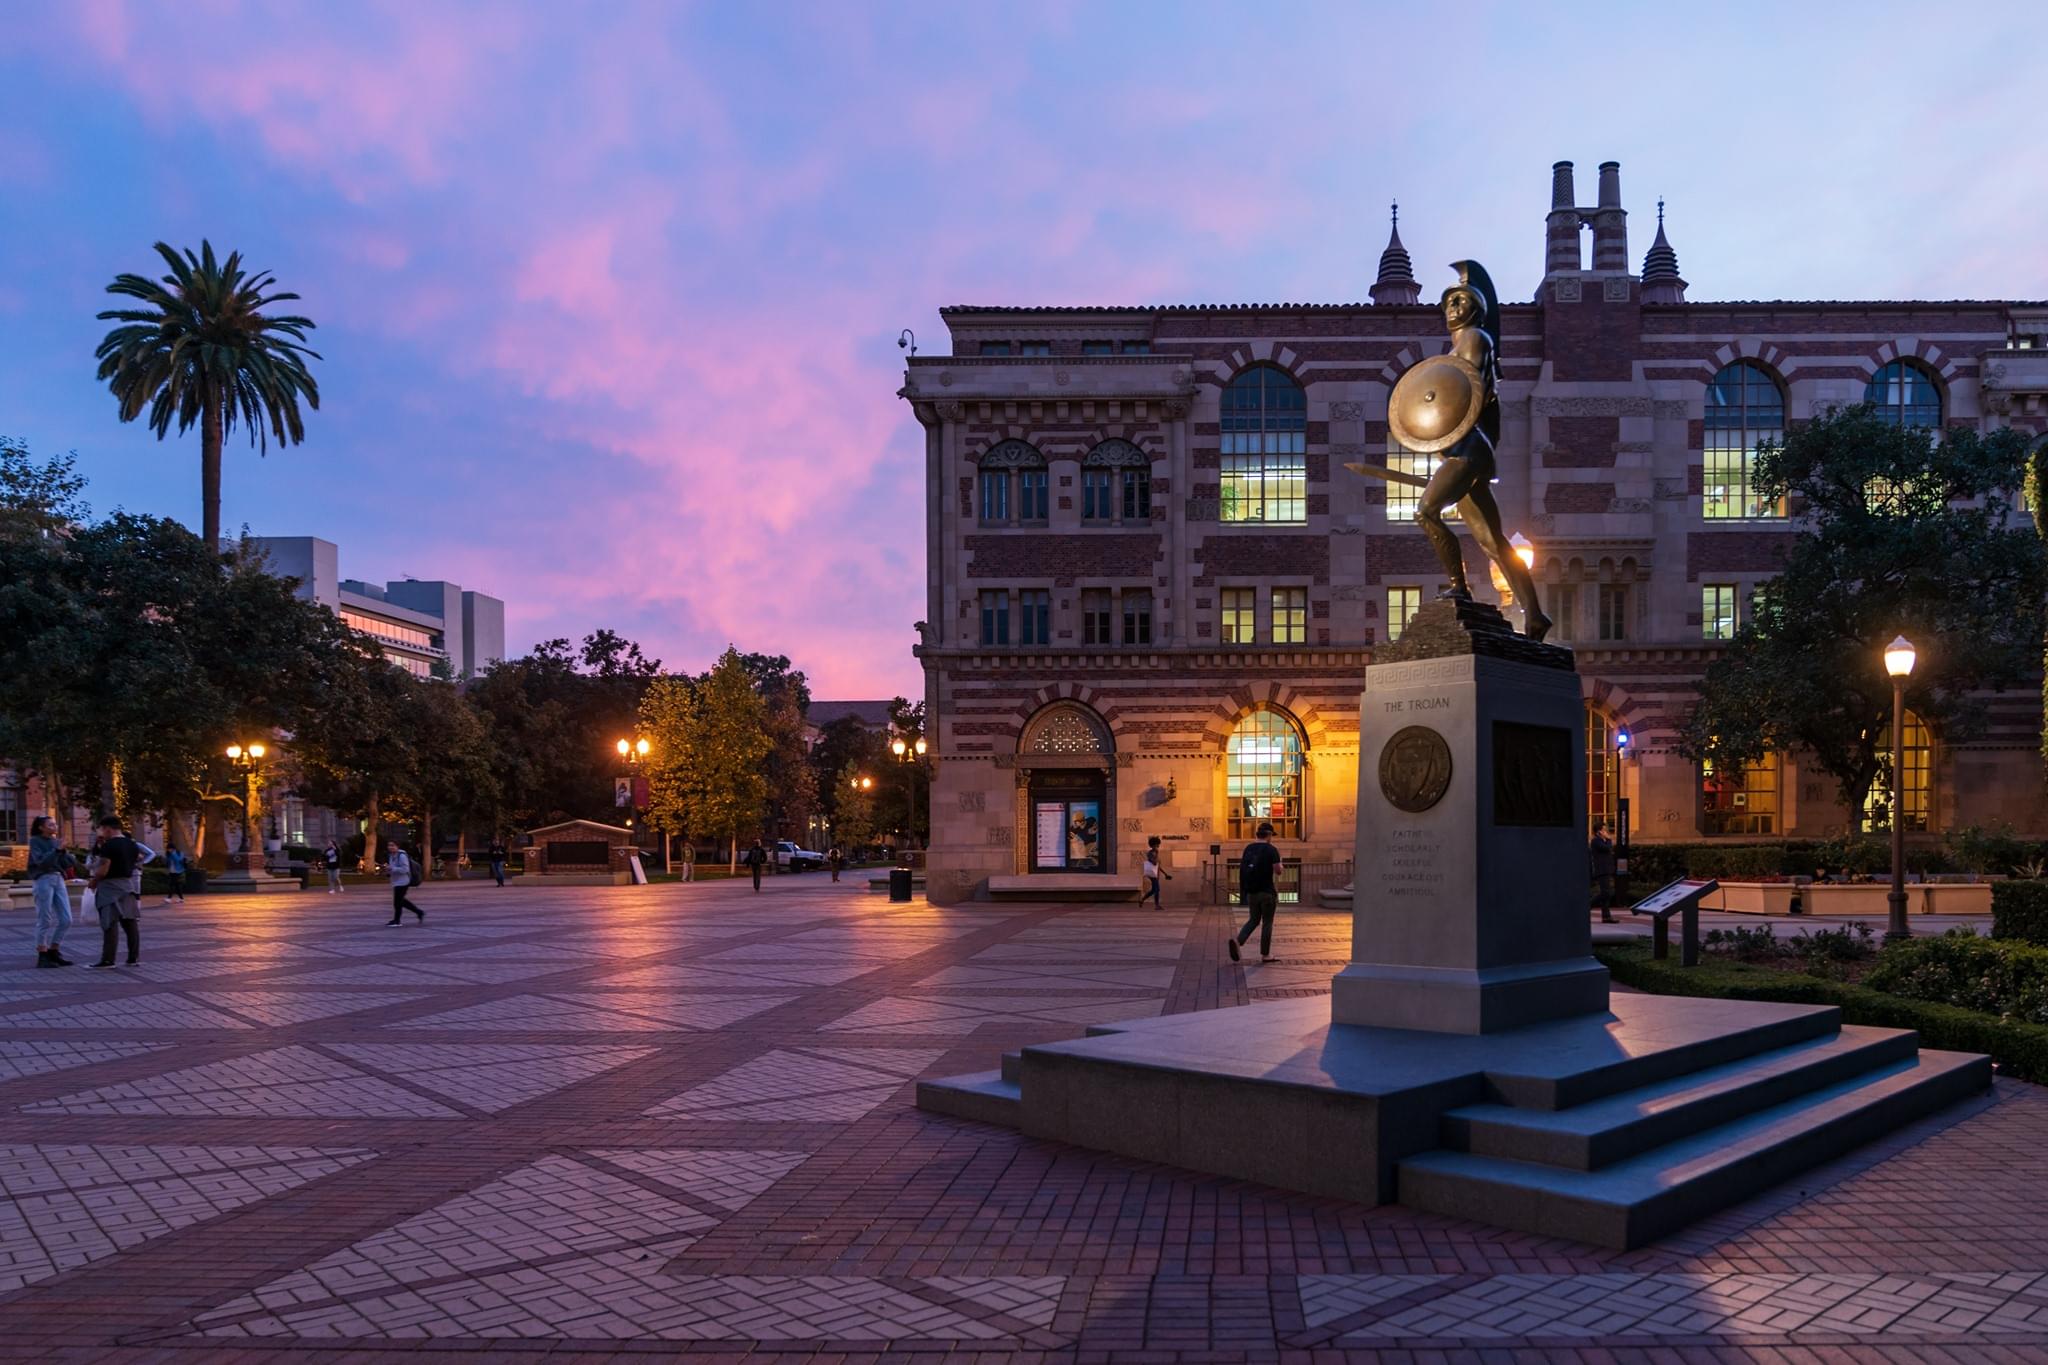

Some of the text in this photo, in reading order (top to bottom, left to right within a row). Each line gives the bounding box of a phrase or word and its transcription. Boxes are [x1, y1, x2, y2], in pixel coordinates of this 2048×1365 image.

[1384, 696, 1450, 713] THE TROJAN
[1388, 887, 1440, 897] AMBITIOU
